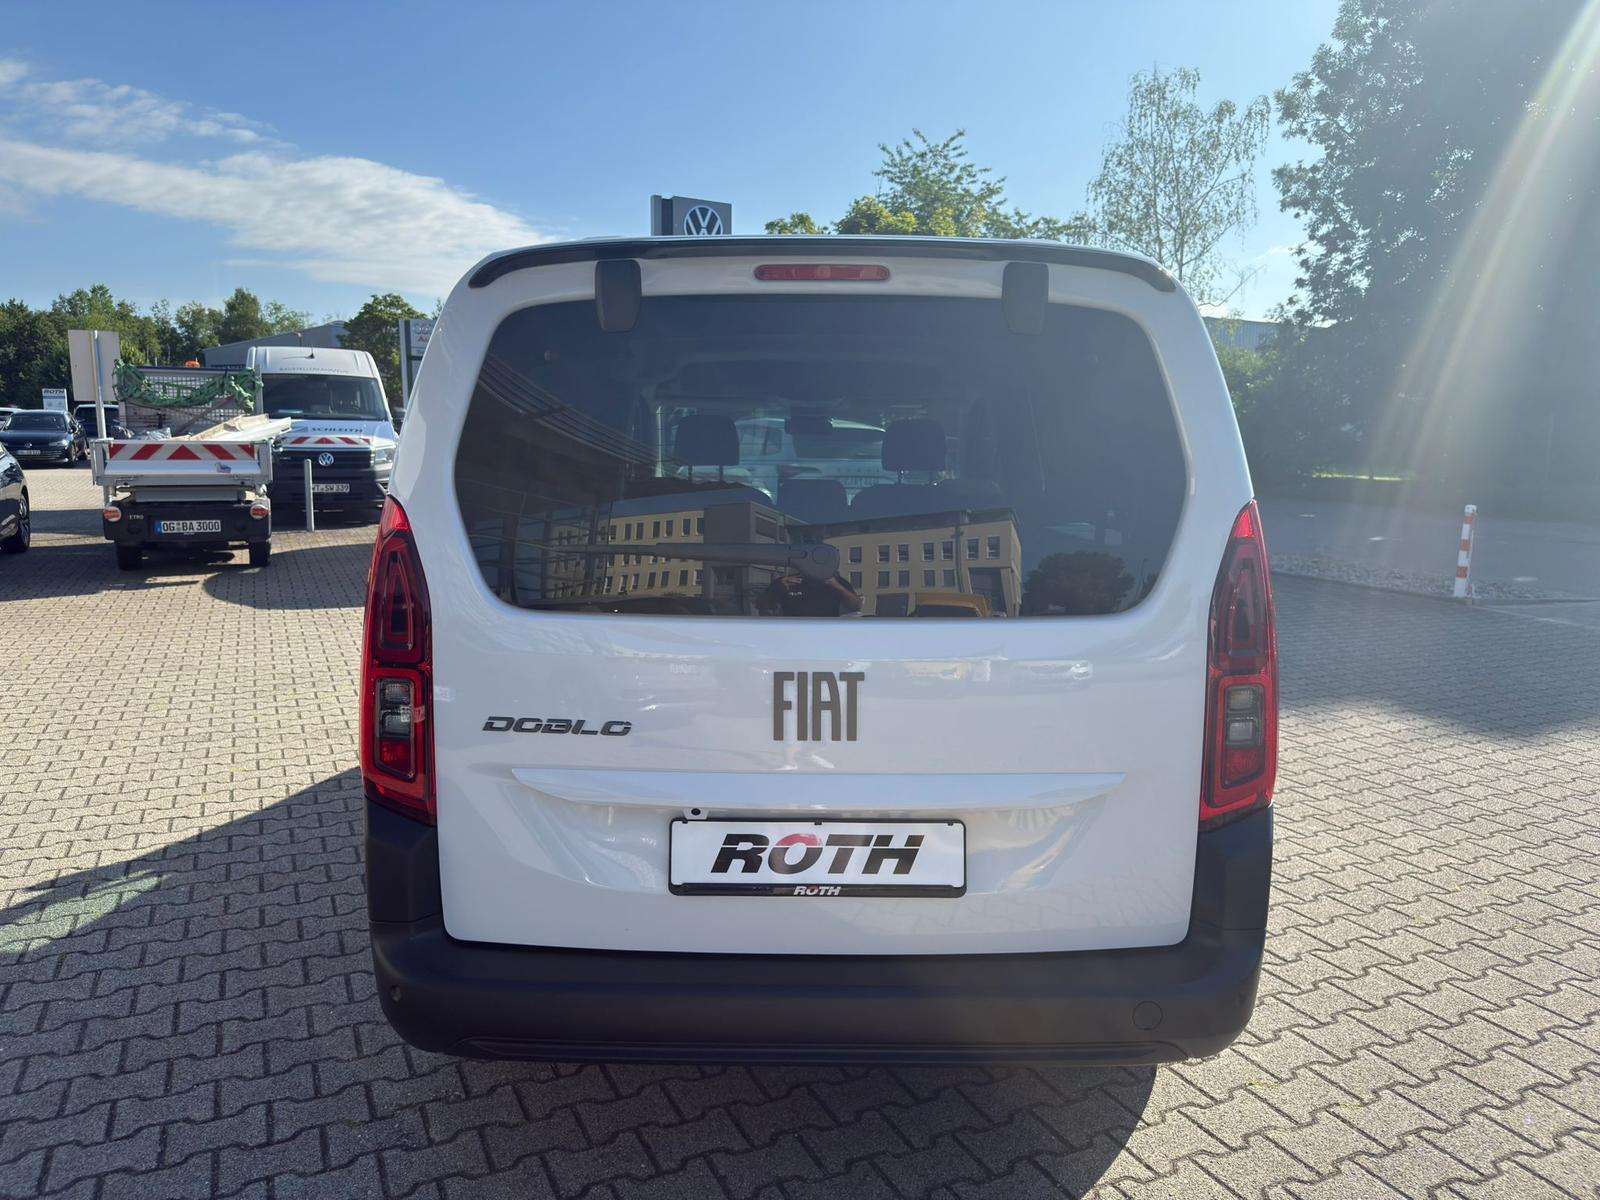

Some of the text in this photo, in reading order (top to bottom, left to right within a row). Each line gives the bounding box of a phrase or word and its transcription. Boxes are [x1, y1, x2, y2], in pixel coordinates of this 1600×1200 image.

[162, 522, 175, 532] OG
[196, 521, 220, 531] 3000
[773, 671, 865, 742] FIAT
[710, 833, 925, 875] ROTH
[793, 885, 842, 896] ROTH
